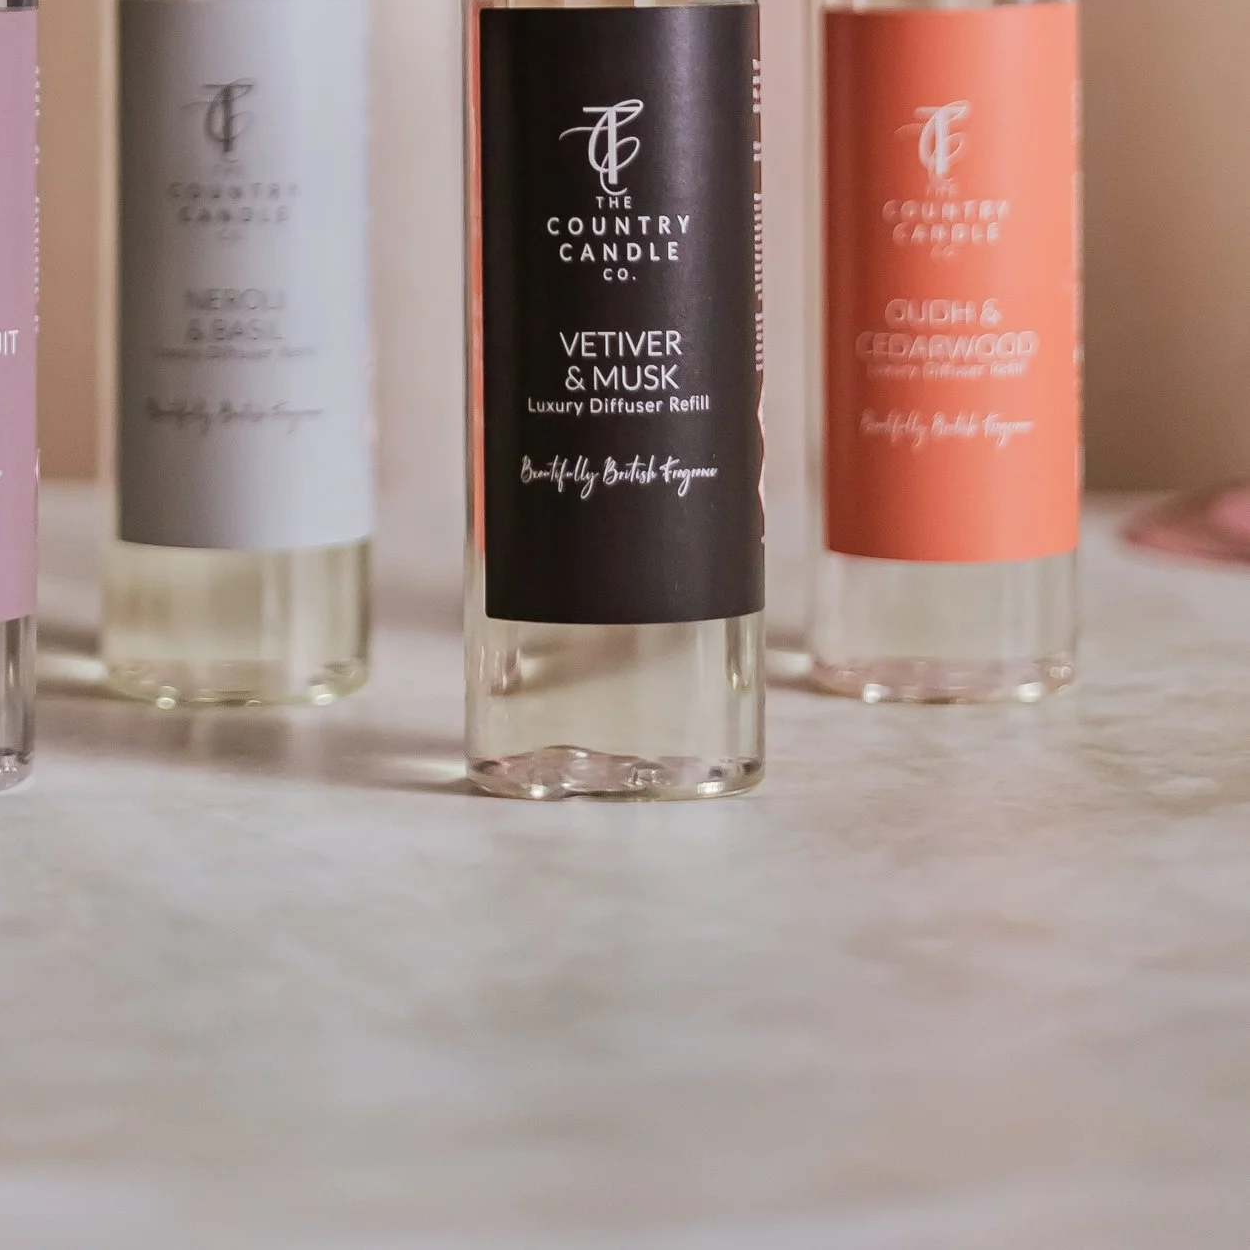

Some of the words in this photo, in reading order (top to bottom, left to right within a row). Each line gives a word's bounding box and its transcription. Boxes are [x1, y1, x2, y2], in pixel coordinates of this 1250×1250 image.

[596, 196, 632, 209] THE
[547, 214, 691, 236] COUNTRY
[559, 241, 680, 262] CANDLE
[603, 267, 636, 281] CO.
[885, 299, 976, 328] OUDH
[980, 298, 1003, 328] &
[559, 330, 683, 358] VETIVER
[855, 331, 1039, 362] CEDARWOOD
[565, 365, 586, 391] &
[593, 363, 680, 391] MUSK
[527, 397, 584, 417] Luxury
[589, 397, 664, 414] Diffuser
[669, 394, 710, 413] Refill
[602, 454, 657, 487] British
